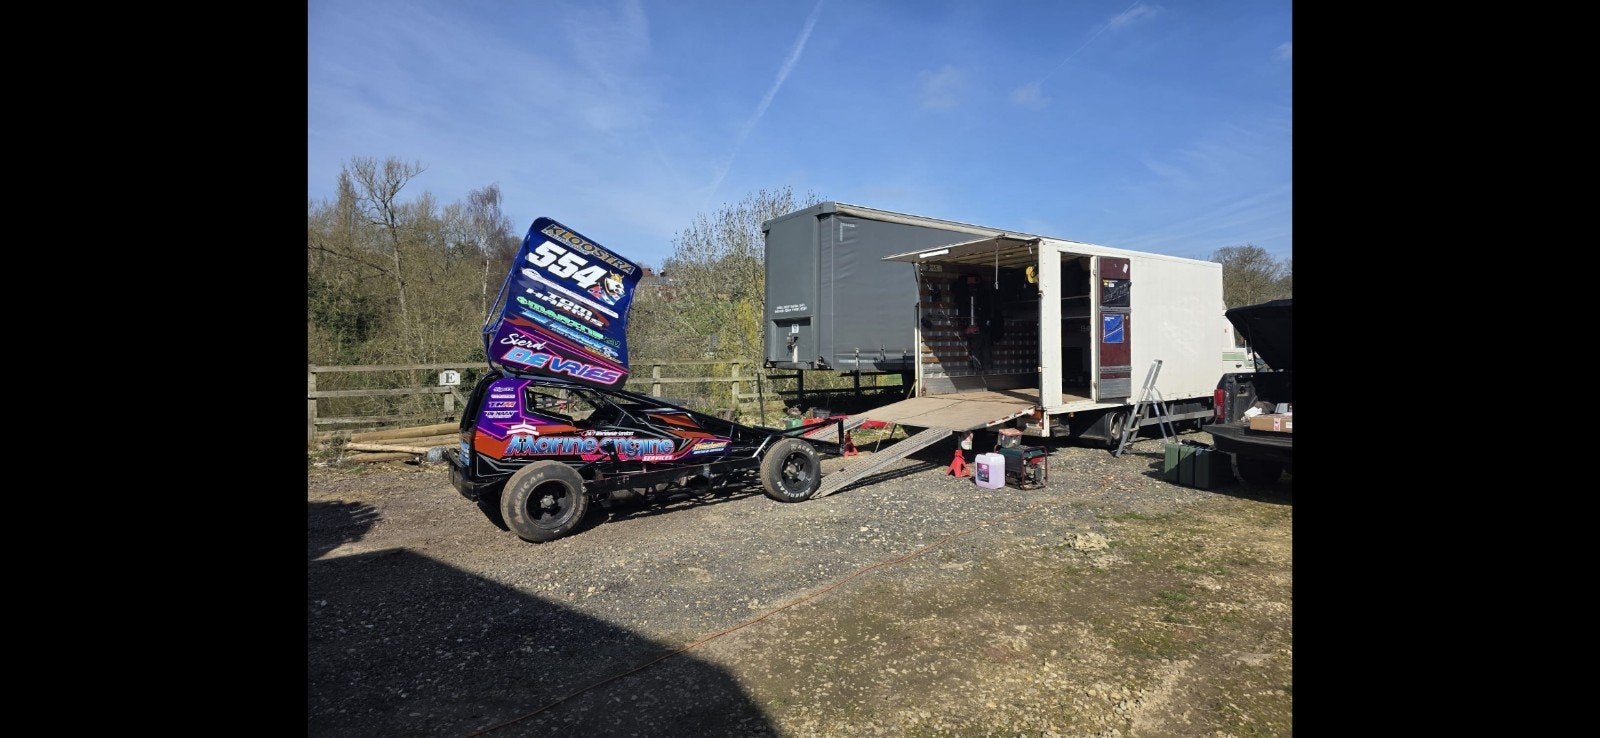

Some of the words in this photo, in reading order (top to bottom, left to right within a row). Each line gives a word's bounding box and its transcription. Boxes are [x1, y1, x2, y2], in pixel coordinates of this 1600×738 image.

[527, 240, 607, 289] 554
[546, 225, 634, 273] KLOOSTRA
[500, 332, 547, 350] Sierd
[445, 373, 456, 383] E
[501, 347, 552, 368] DE
[550, 356, 623, 385] VRIES
[505, 434, 600, 457] Marine
[600, 436, 676, 458] engine
